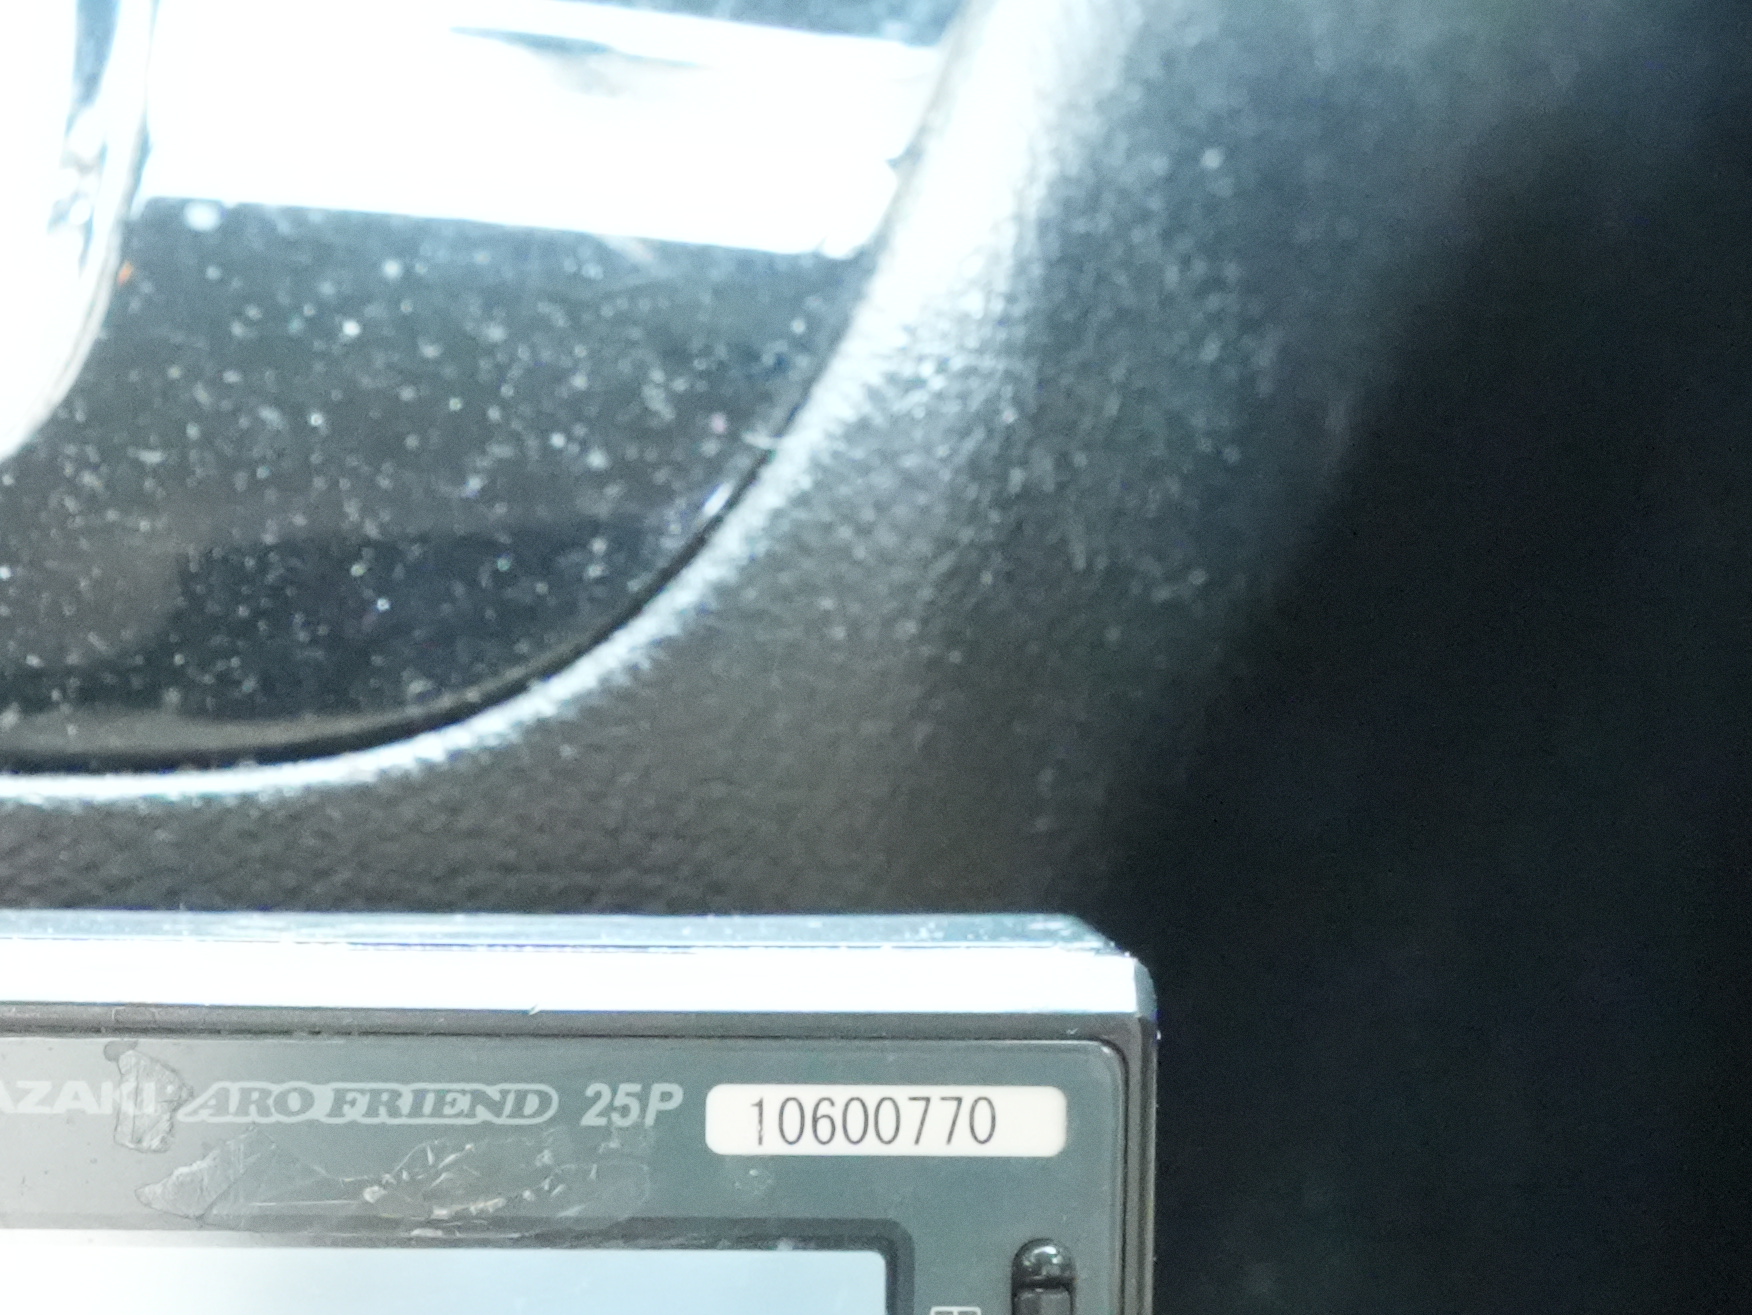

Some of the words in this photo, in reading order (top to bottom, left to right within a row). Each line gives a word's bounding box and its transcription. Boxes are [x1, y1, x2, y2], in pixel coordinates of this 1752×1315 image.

[178, 1081, 328, 1123] ARO
[322, 1083, 560, 1125] FRIEND
[580, 1083, 685, 1127] 25P
[751, 1096, 997, 1146] 10600770
